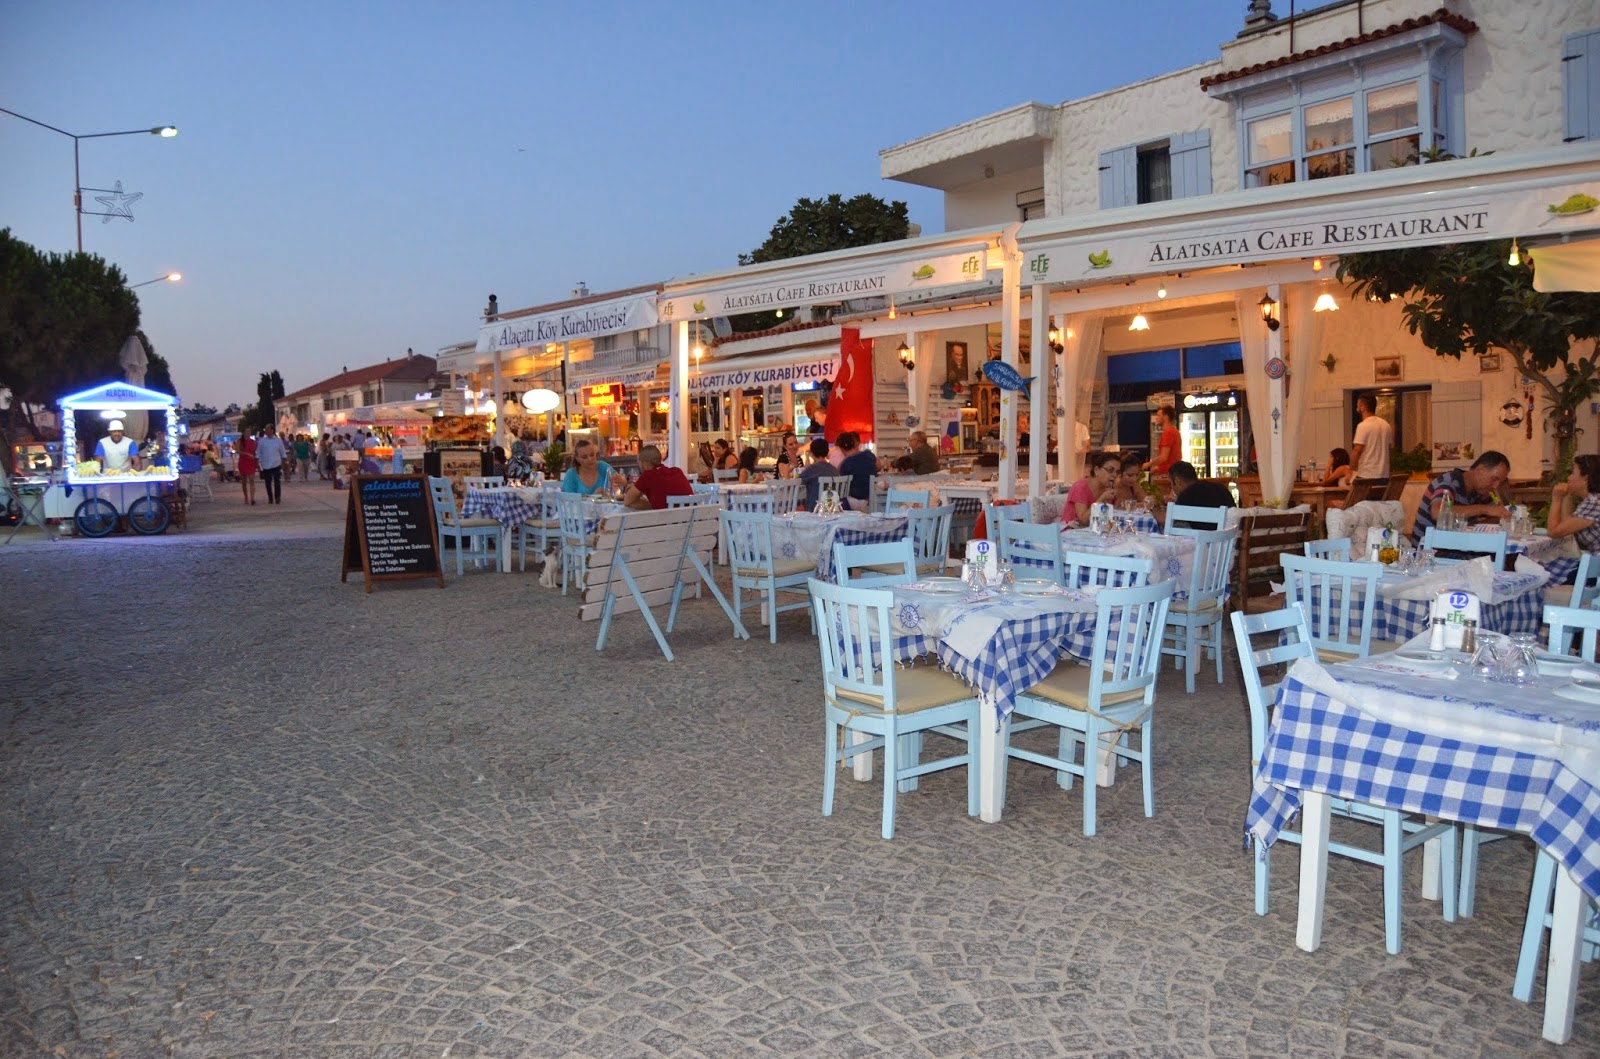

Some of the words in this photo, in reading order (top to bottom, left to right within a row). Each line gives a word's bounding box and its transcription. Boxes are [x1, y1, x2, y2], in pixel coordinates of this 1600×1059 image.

[1149, 238, 1250, 262] ALATSATA
[1257, 231, 1314, 252] CAFE
[1321, 211, 1489, 245] RESTAURANT
[962, 256, 979, 274] EFE
[1030, 254, 1050, 273] EFE
[723, 293, 774, 309] ALATSATA
[776, 287, 805, 303] CAFE
[808, 276, 885, 297] RESTAURANT
[499, 326, 534, 348] Alaçatı
[537, 320, 558, 343] Köy
[561, 306, 626, 337] Kurabiyecisi
[727, 370, 751, 385] KÖY
[753, 359, 834, 382] KURABİYECİSİ
[363, 480, 420, 491] alatsata
[978, 544, 988, 552] 11
[1451, 594, 1467, 606] 12
